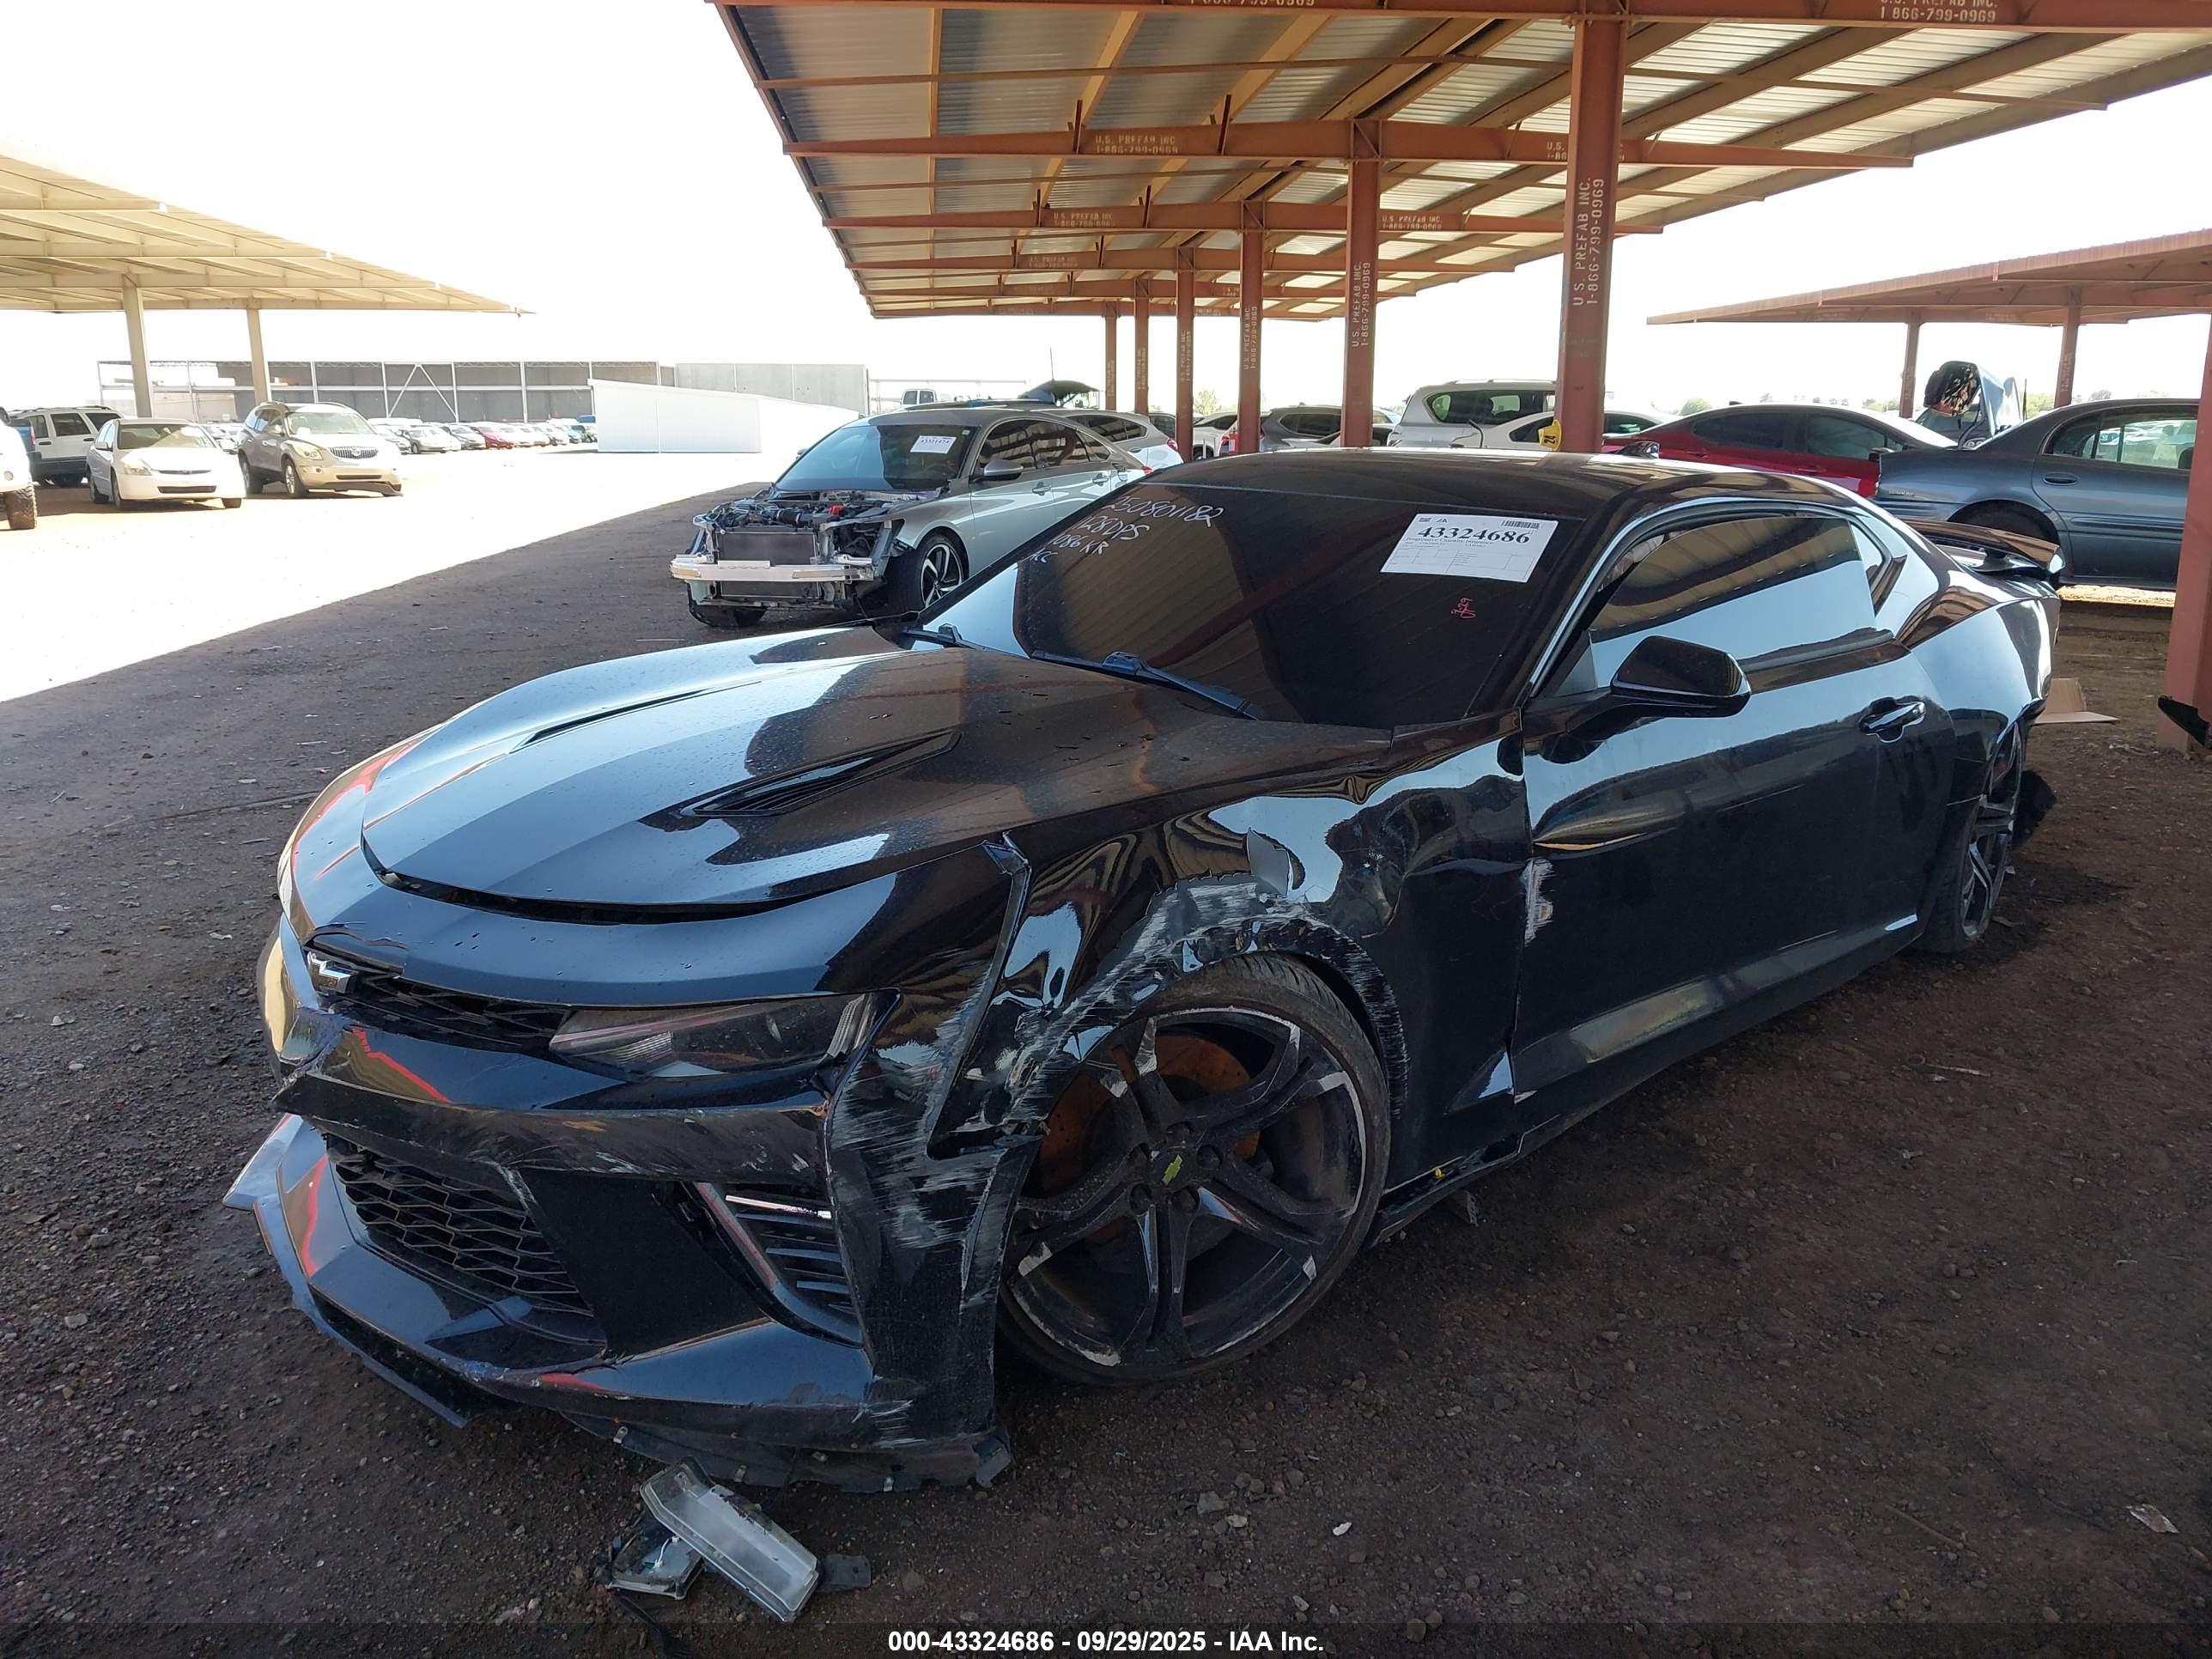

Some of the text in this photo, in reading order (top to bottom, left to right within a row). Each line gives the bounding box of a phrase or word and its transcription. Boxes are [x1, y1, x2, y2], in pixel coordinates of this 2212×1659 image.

[1575, 213, 1589, 270] PREFAB
[1587, 179, 1604, 304] 1-866-799-0969
[1352, 285, 1361, 323] PREFAB
[1361, 262, 1370, 346] 1-866-799-0969
[1418, 526, 1532, 544] 43324686
